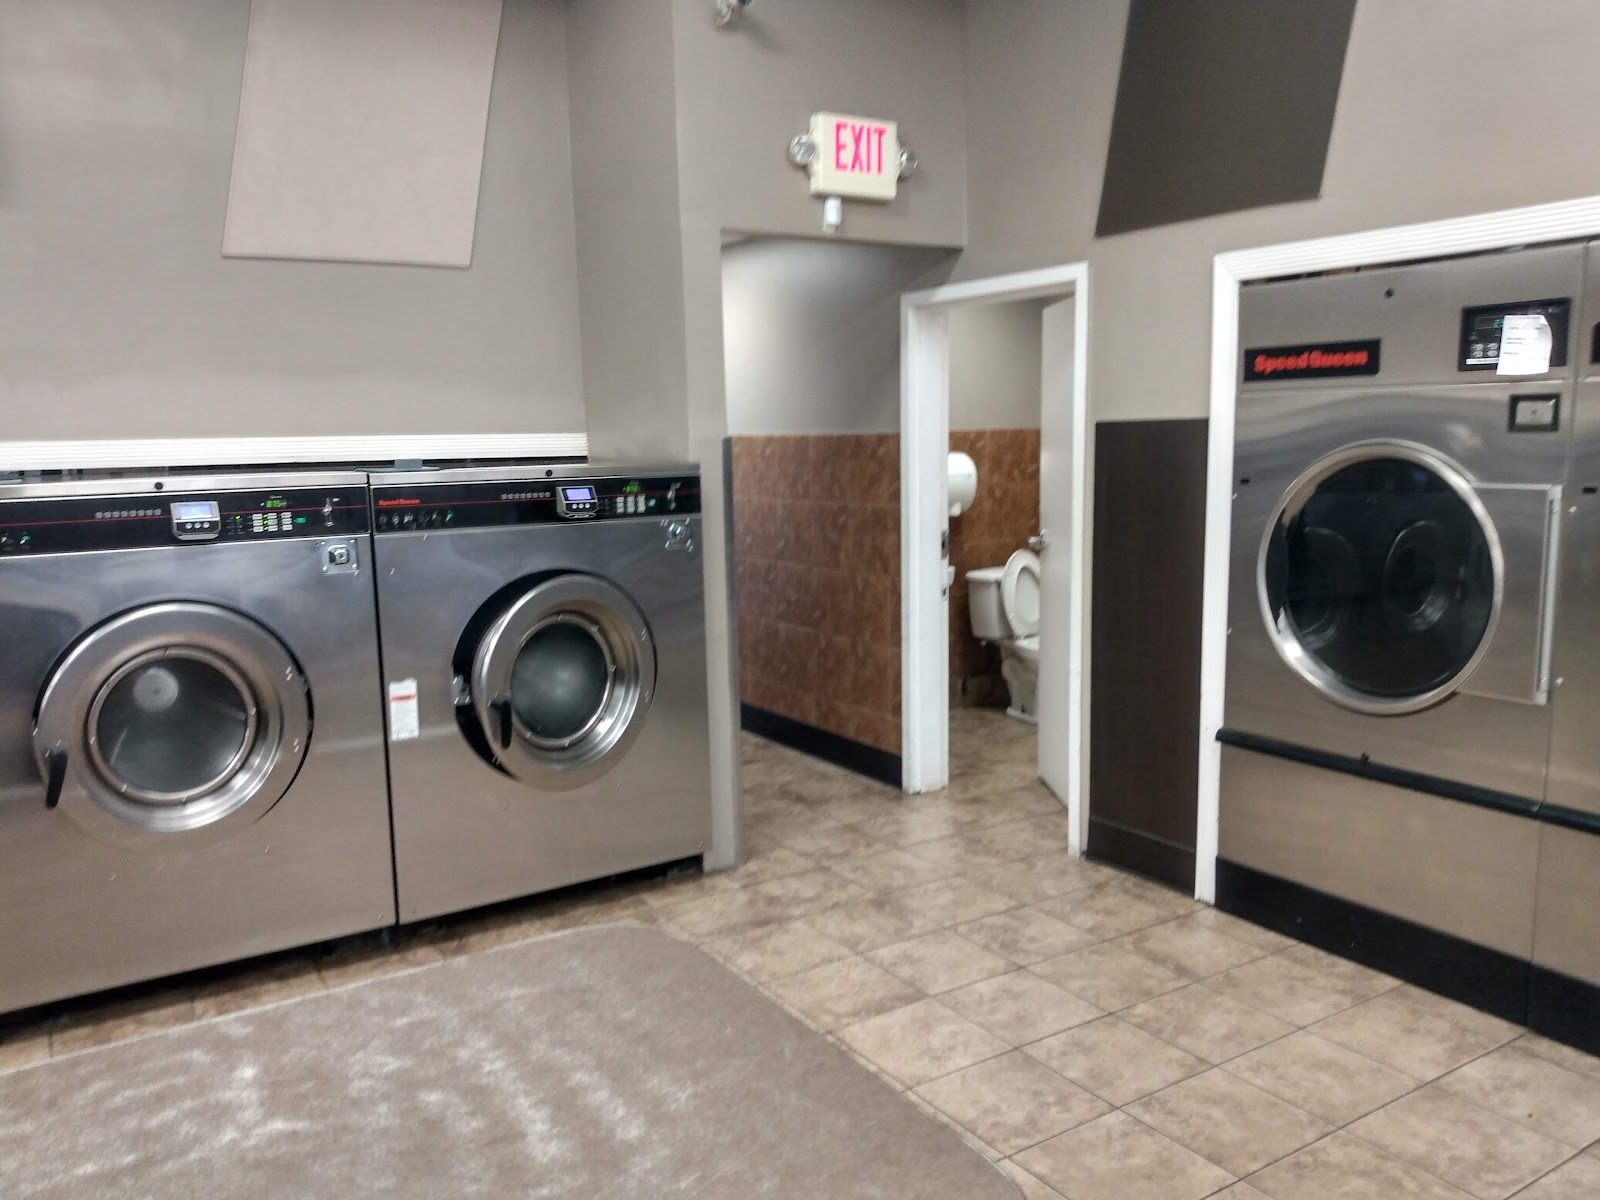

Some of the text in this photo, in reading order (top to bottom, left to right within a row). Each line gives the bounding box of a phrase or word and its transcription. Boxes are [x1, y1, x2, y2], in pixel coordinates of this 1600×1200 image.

[835, 120, 887, 175] EXIT
[1254, 349, 1368, 375] Speed Queen
